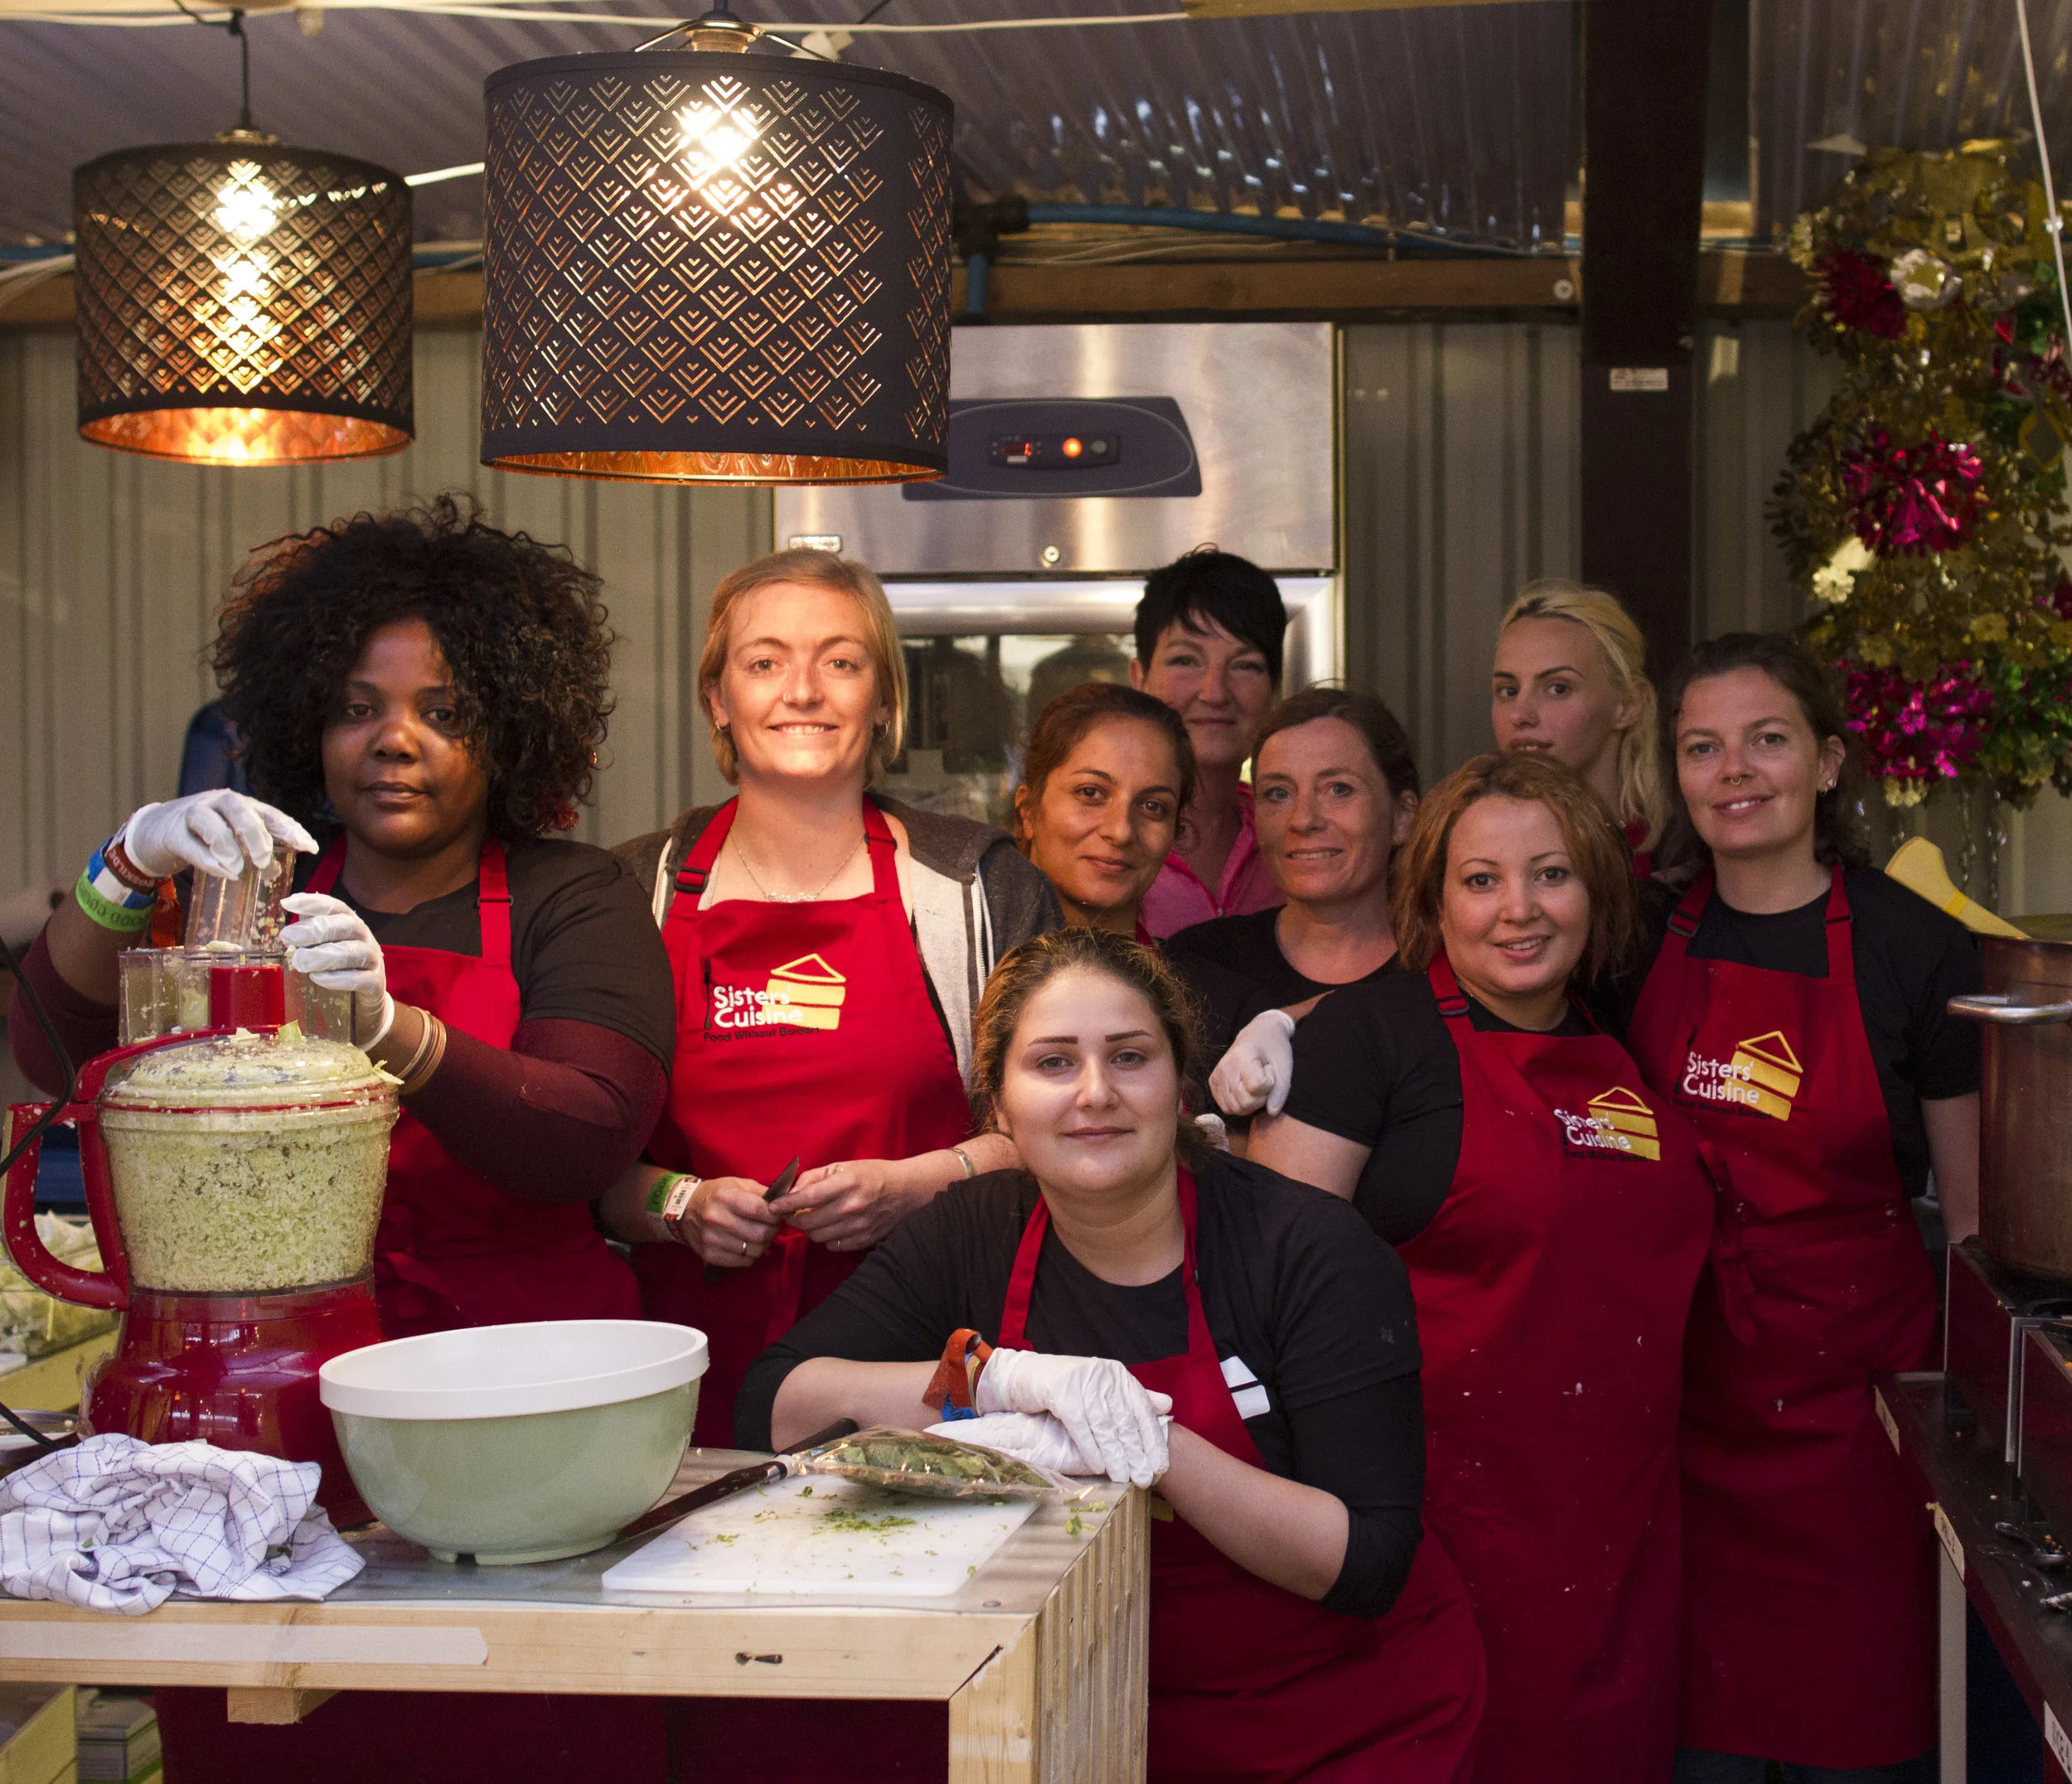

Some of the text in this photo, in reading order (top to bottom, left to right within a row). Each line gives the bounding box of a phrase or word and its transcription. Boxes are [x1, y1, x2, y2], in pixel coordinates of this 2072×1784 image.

[714, 1005, 803, 1027] Cuisine
[704, 1026, 820, 1042] Food Without Borders
[1682, 1074, 1760, 1105] Cuisine
[1566, 1125, 1631, 1149] Cuisine
